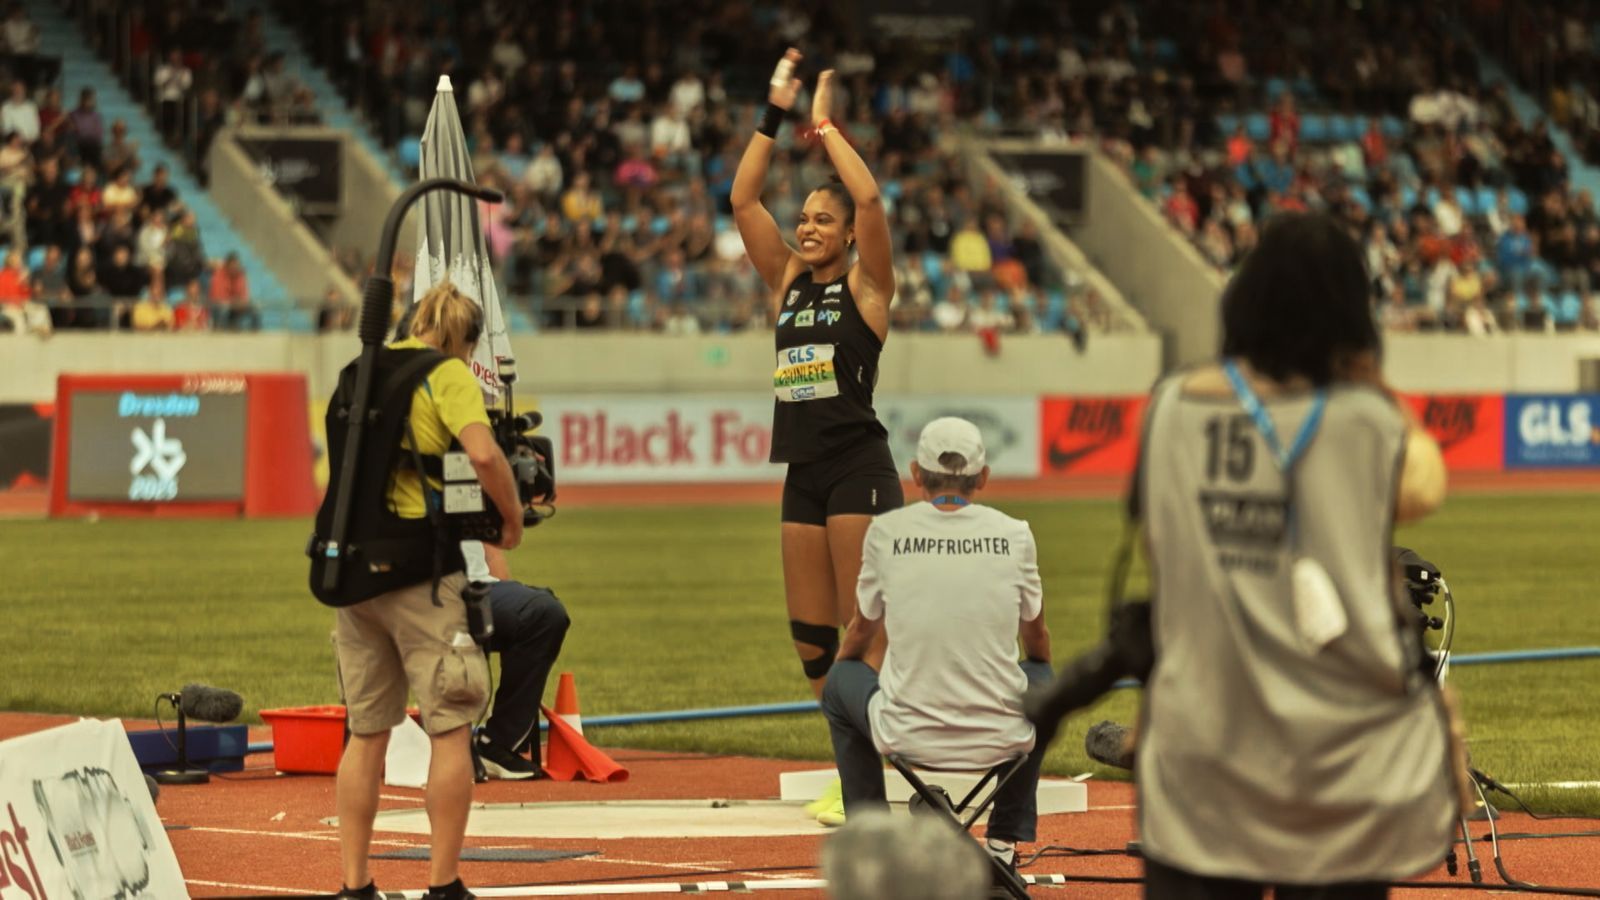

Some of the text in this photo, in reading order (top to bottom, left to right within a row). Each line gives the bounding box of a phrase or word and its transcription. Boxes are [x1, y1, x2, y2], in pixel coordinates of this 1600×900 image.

[119, 392, 199, 417] Dresden
[1519, 402, 1591, 446] GLS
[561, 409, 694, 467] Black
[1205, 413, 1255, 483] 15
[893, 536, 1010, 555] KAMPFRICHTER
